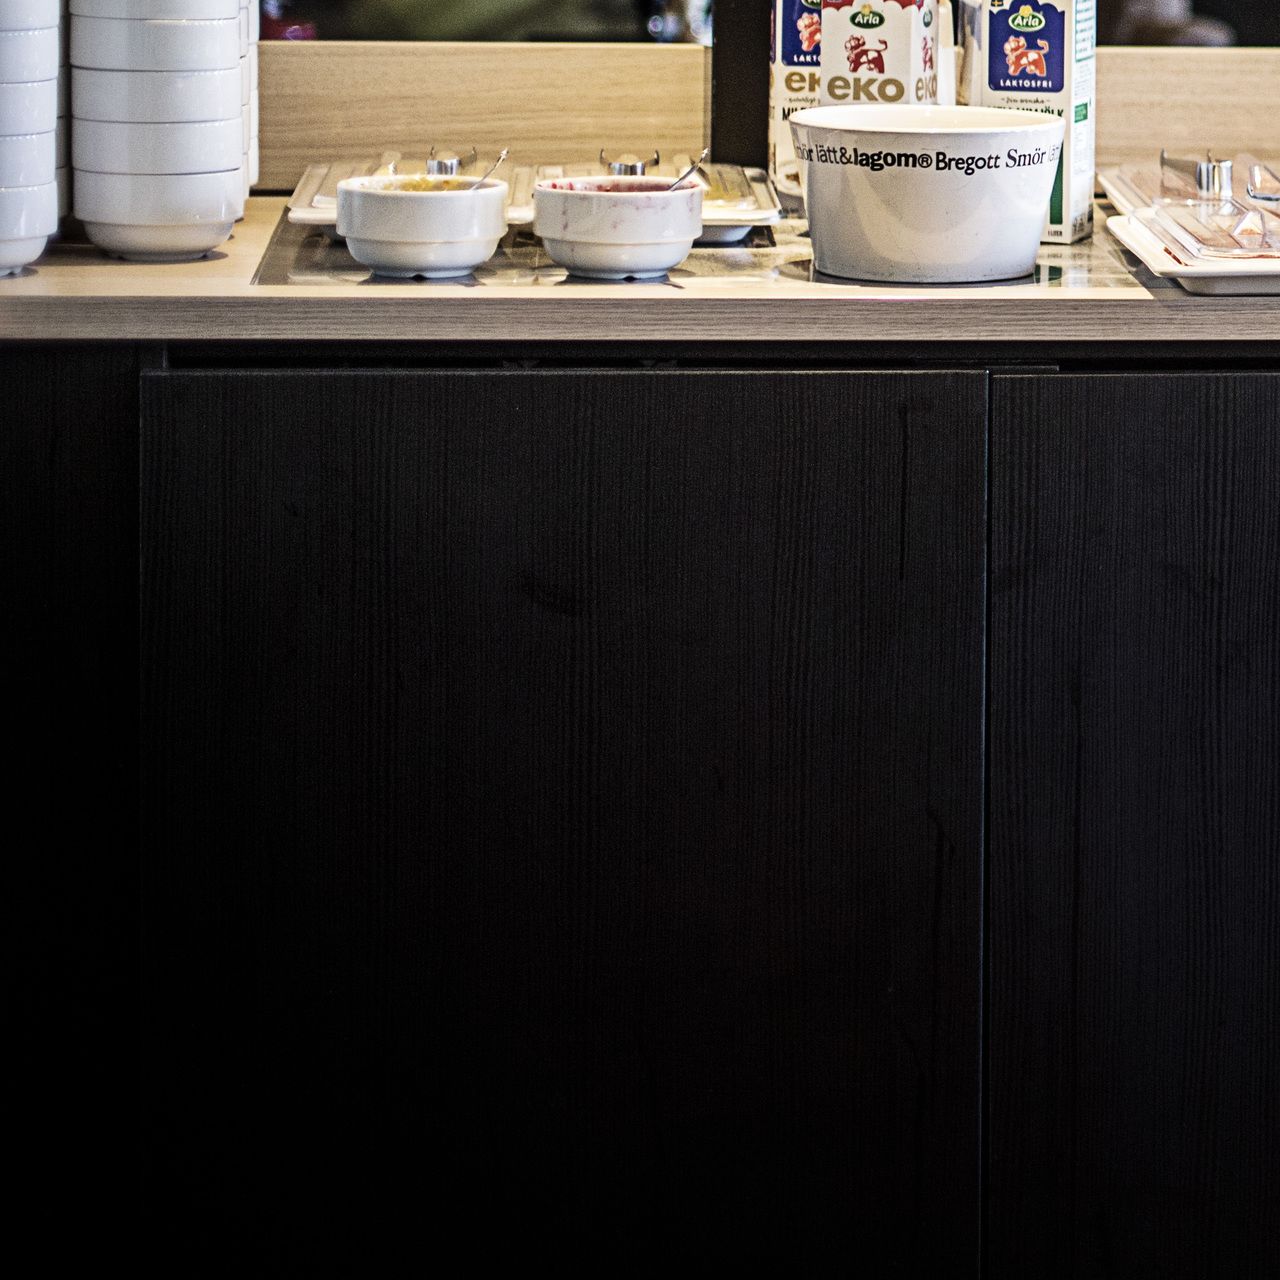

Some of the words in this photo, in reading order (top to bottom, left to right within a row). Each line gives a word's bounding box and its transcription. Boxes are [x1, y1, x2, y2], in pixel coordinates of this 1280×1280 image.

[855, 14, 880, 26] Arla
[1014, 14, 1040, 28] Arla
[793, 54, 821, 63] LAKT
[785, 71, 821, 92] ek
[827, 75, 905, 102] eko
[1000, 79, 1053, 89] LAKTOSFRI
[936, 151, 1001, 176] Bregott
[1005, 147, 1047, 169] Smör
